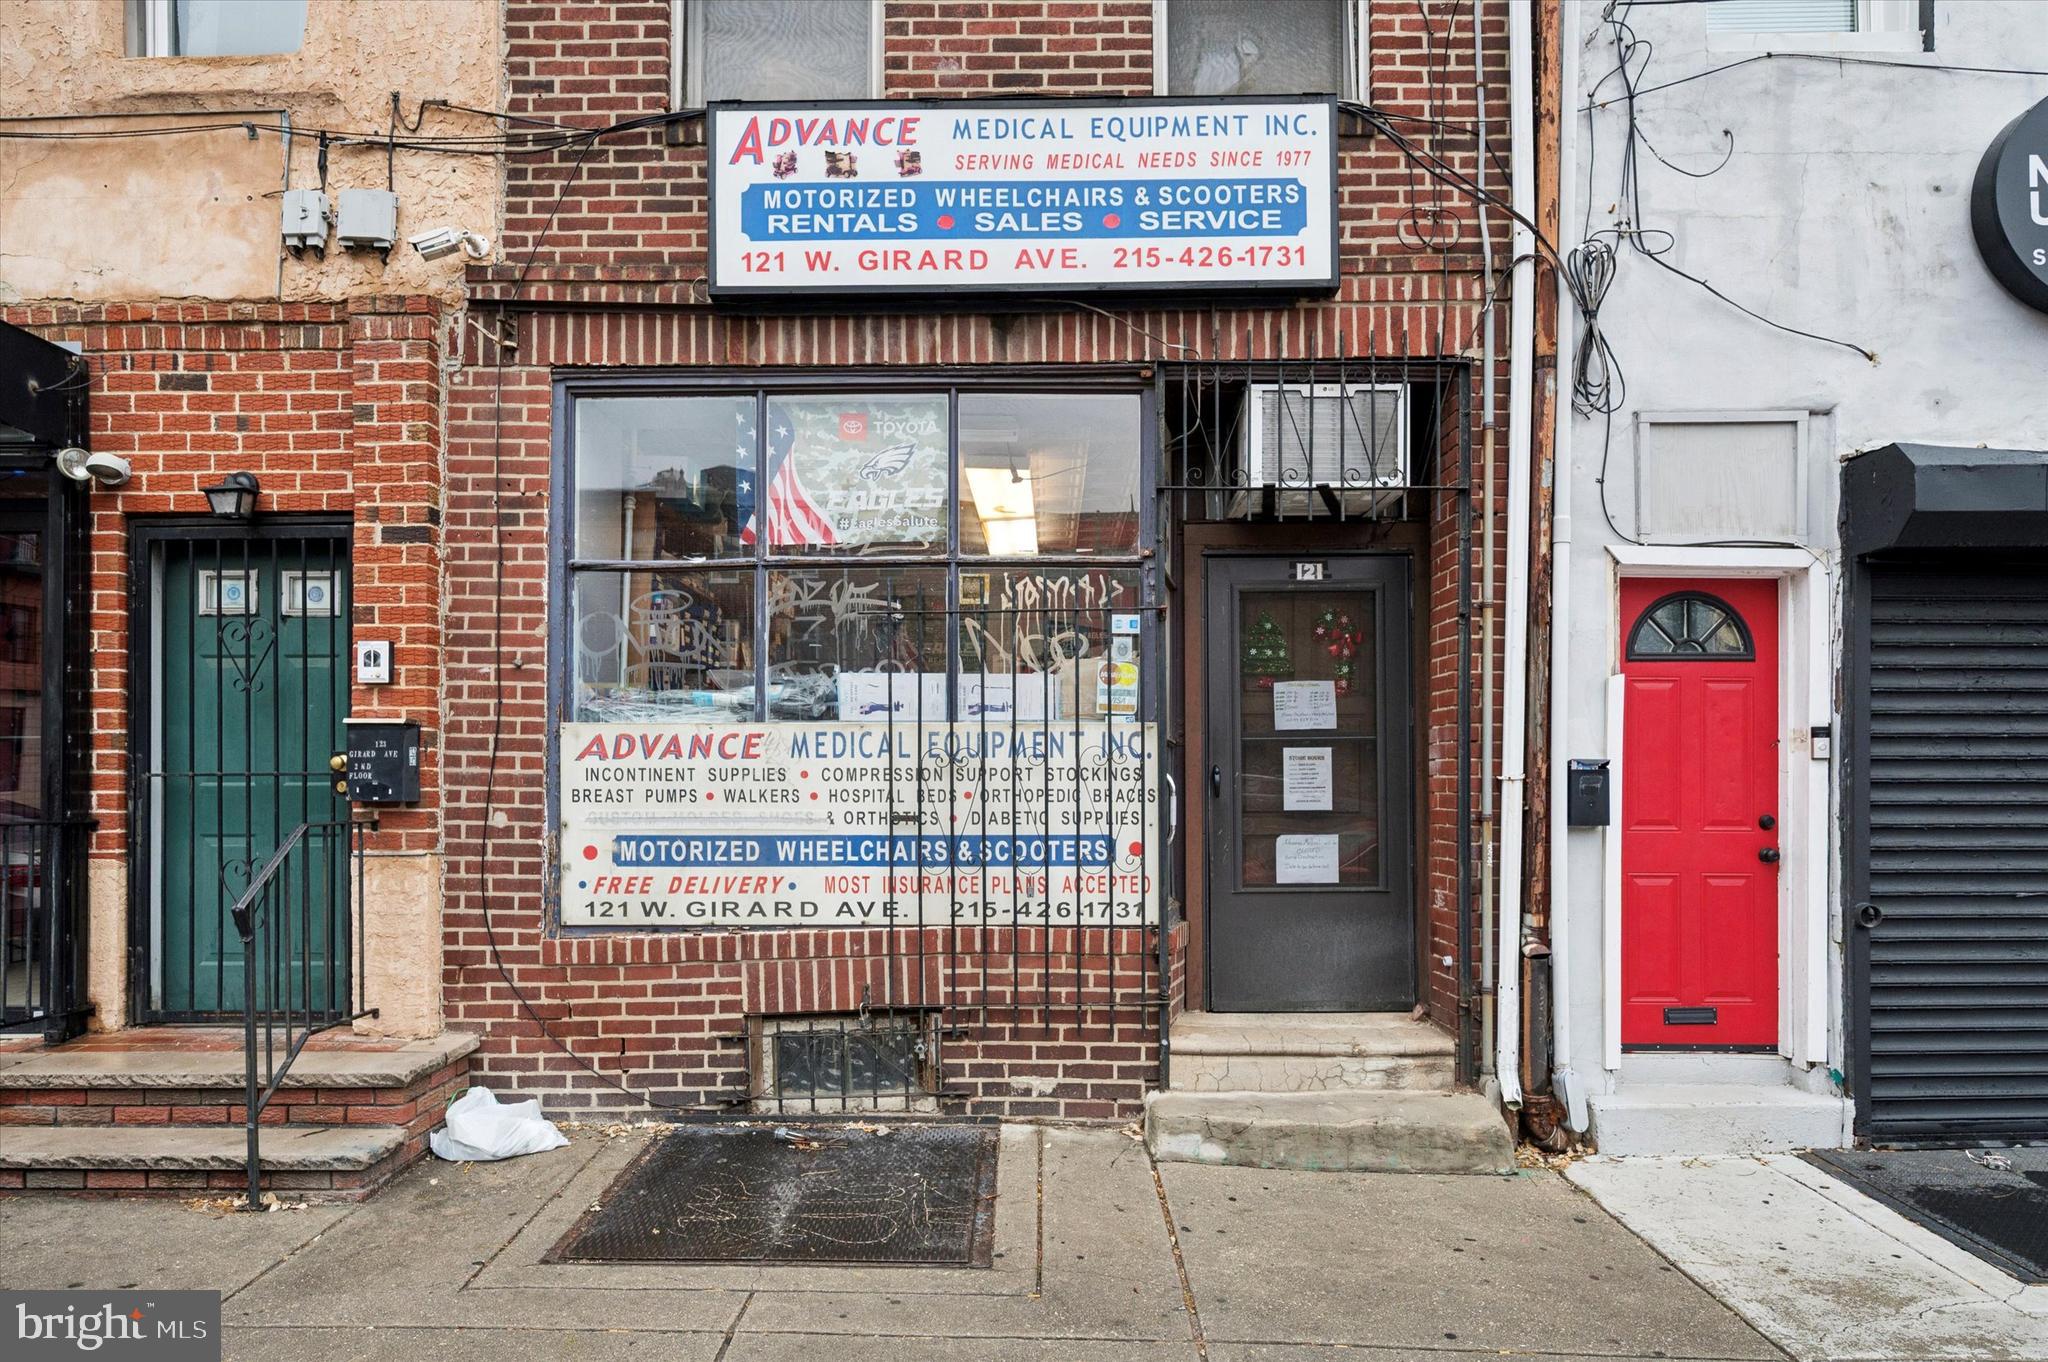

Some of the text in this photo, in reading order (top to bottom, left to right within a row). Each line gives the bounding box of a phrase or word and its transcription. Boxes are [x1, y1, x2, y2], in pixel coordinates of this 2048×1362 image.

[729, 114, 1317, 165] ADVANCE MEDICAL EQUIPMENT INC.
[955, 150, 1311, 171] SERVING MEDICAL NEEDS SINCE 1977
[763, 185, 1300, 209] MOTORIZED WHEELCHAIRS & SCOOTERS
[768, 210, 1282, 234] RENTALS SALES SERVICE
[741, 245, 1305, 273] 121 W. GIRARD AVE. 215-426-1731
[873, 420, 938, 434] TOYOTA
[827, 488, 945, 511] EAGLES
[349, 750, 399, 758] GIRARD AVE
[575, 733, 765, 762] ADVANCE
[790, 731, 911, 759] MEDICAL
[1101, 731, 1152, 759] INC.
[349, 772, 372, 780] FLOOR
[585, 767, 1142, 782] INCONTINENT SUPPLIES COMPRESSION SUPPORT STOCKINGS
[571, 788, 634, 803] BREAST
[645, 788, 698, 803] PUMPS
[723, 788, 800, 803] WALKERS
[829, 788, 905, 803] HOSPITAL
[917, 788, 957, 803] BEDS
[980, 788, 1080, 803] ORTHOPEDIC
[826, 811, 835, 825] &
[843, 811, 939, 826] ORTHOTICS
[971, 811, 1047, 825] DABETIC
[1061, 811, 1140, 826] SUPPLIES
[620, 840, 1108, 862] MOTORIZED WHEELCHAIRS & SCOOTERS
[593, 875, 1151, 895] FREE DELIVERY MOST INSURANCE PLANS ACCEPTED
[584, 901, 628, 918] 121
[640, 901, 675, 918] W.
[686, 901, 819, 918] GIRARD
[835, 901, 909, 918] AVE.
